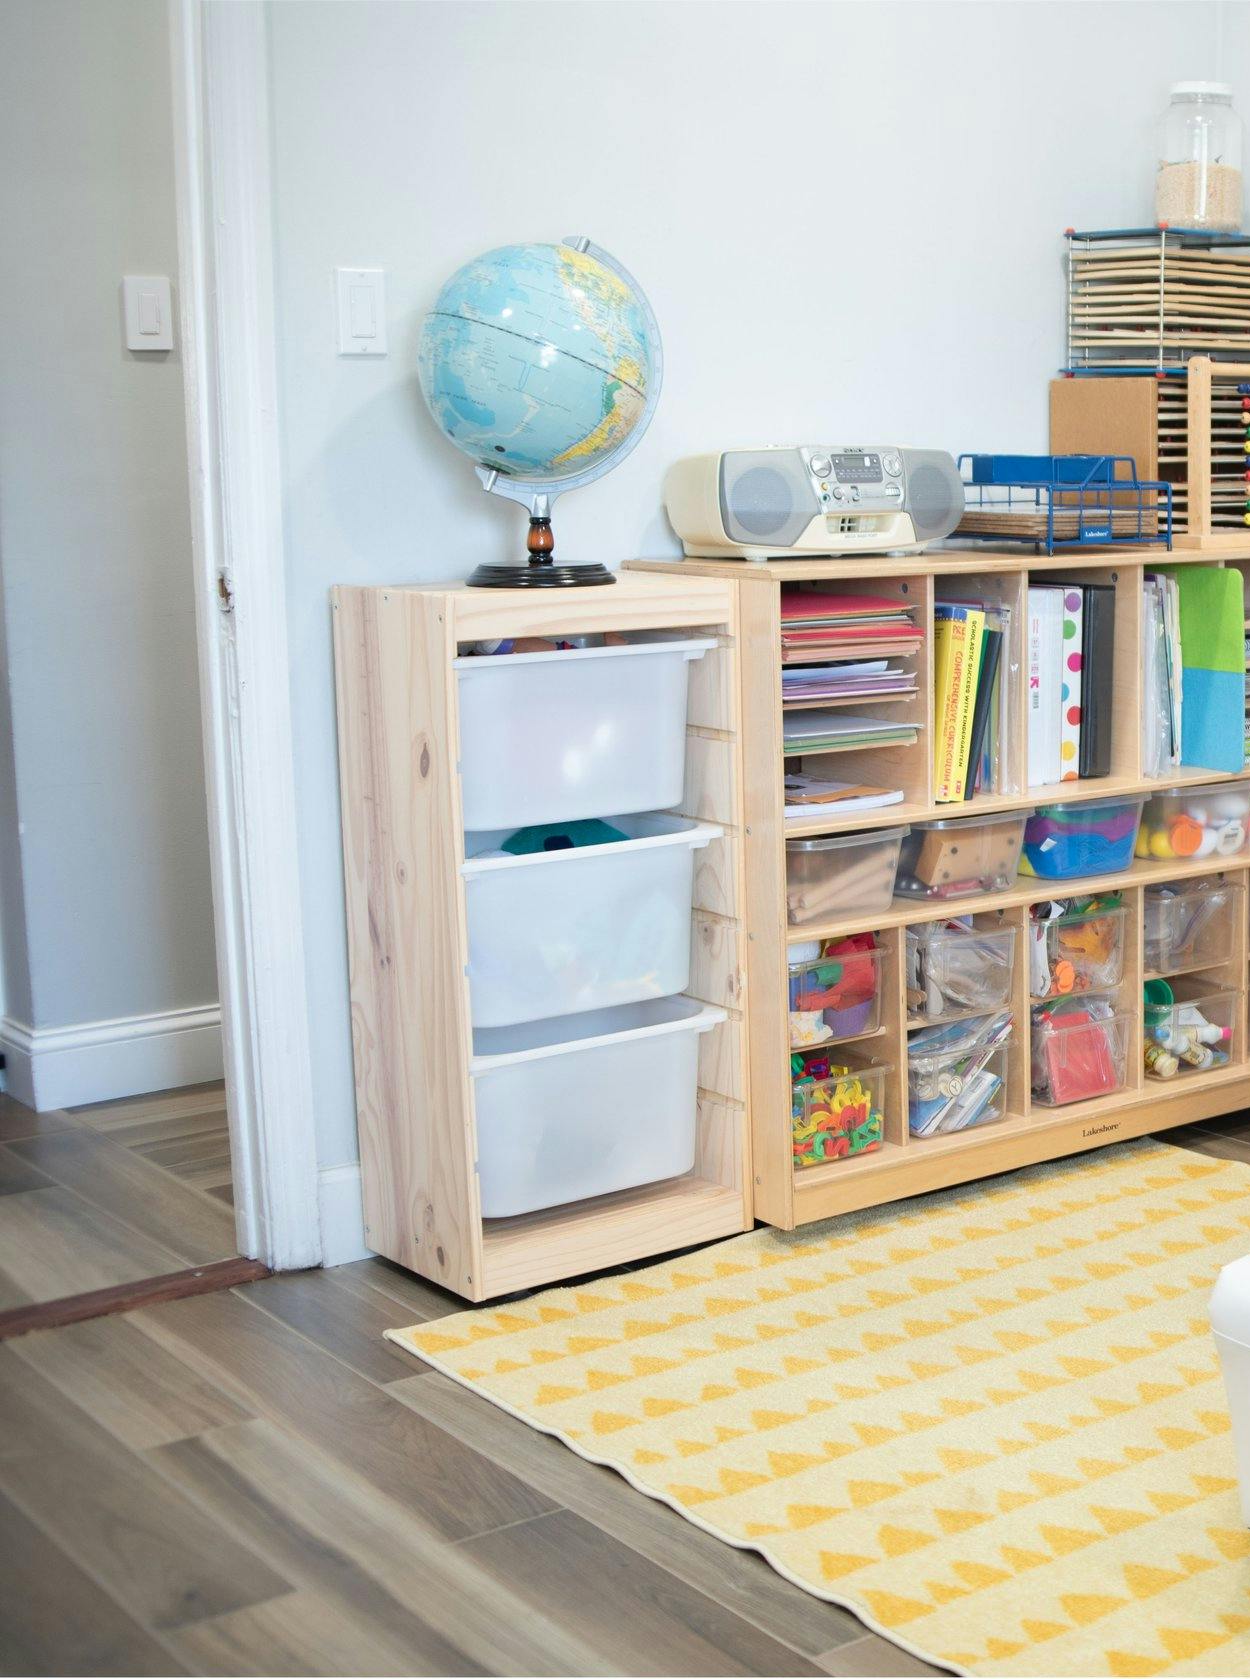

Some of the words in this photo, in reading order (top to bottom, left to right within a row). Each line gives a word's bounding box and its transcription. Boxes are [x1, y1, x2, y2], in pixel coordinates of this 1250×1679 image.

[968, 621, 977, 662] SCHOLASTIC
[949, 651, 963, 722] COMPREHENSIVE
[965, 664, 973, 693] SUCCESS
[944, 725, 956, 782] CURRICULUM
[958, 715, 967, 767] KINDERGARTEN
[1082, 1123, 1119, 1137] Lakeshore
